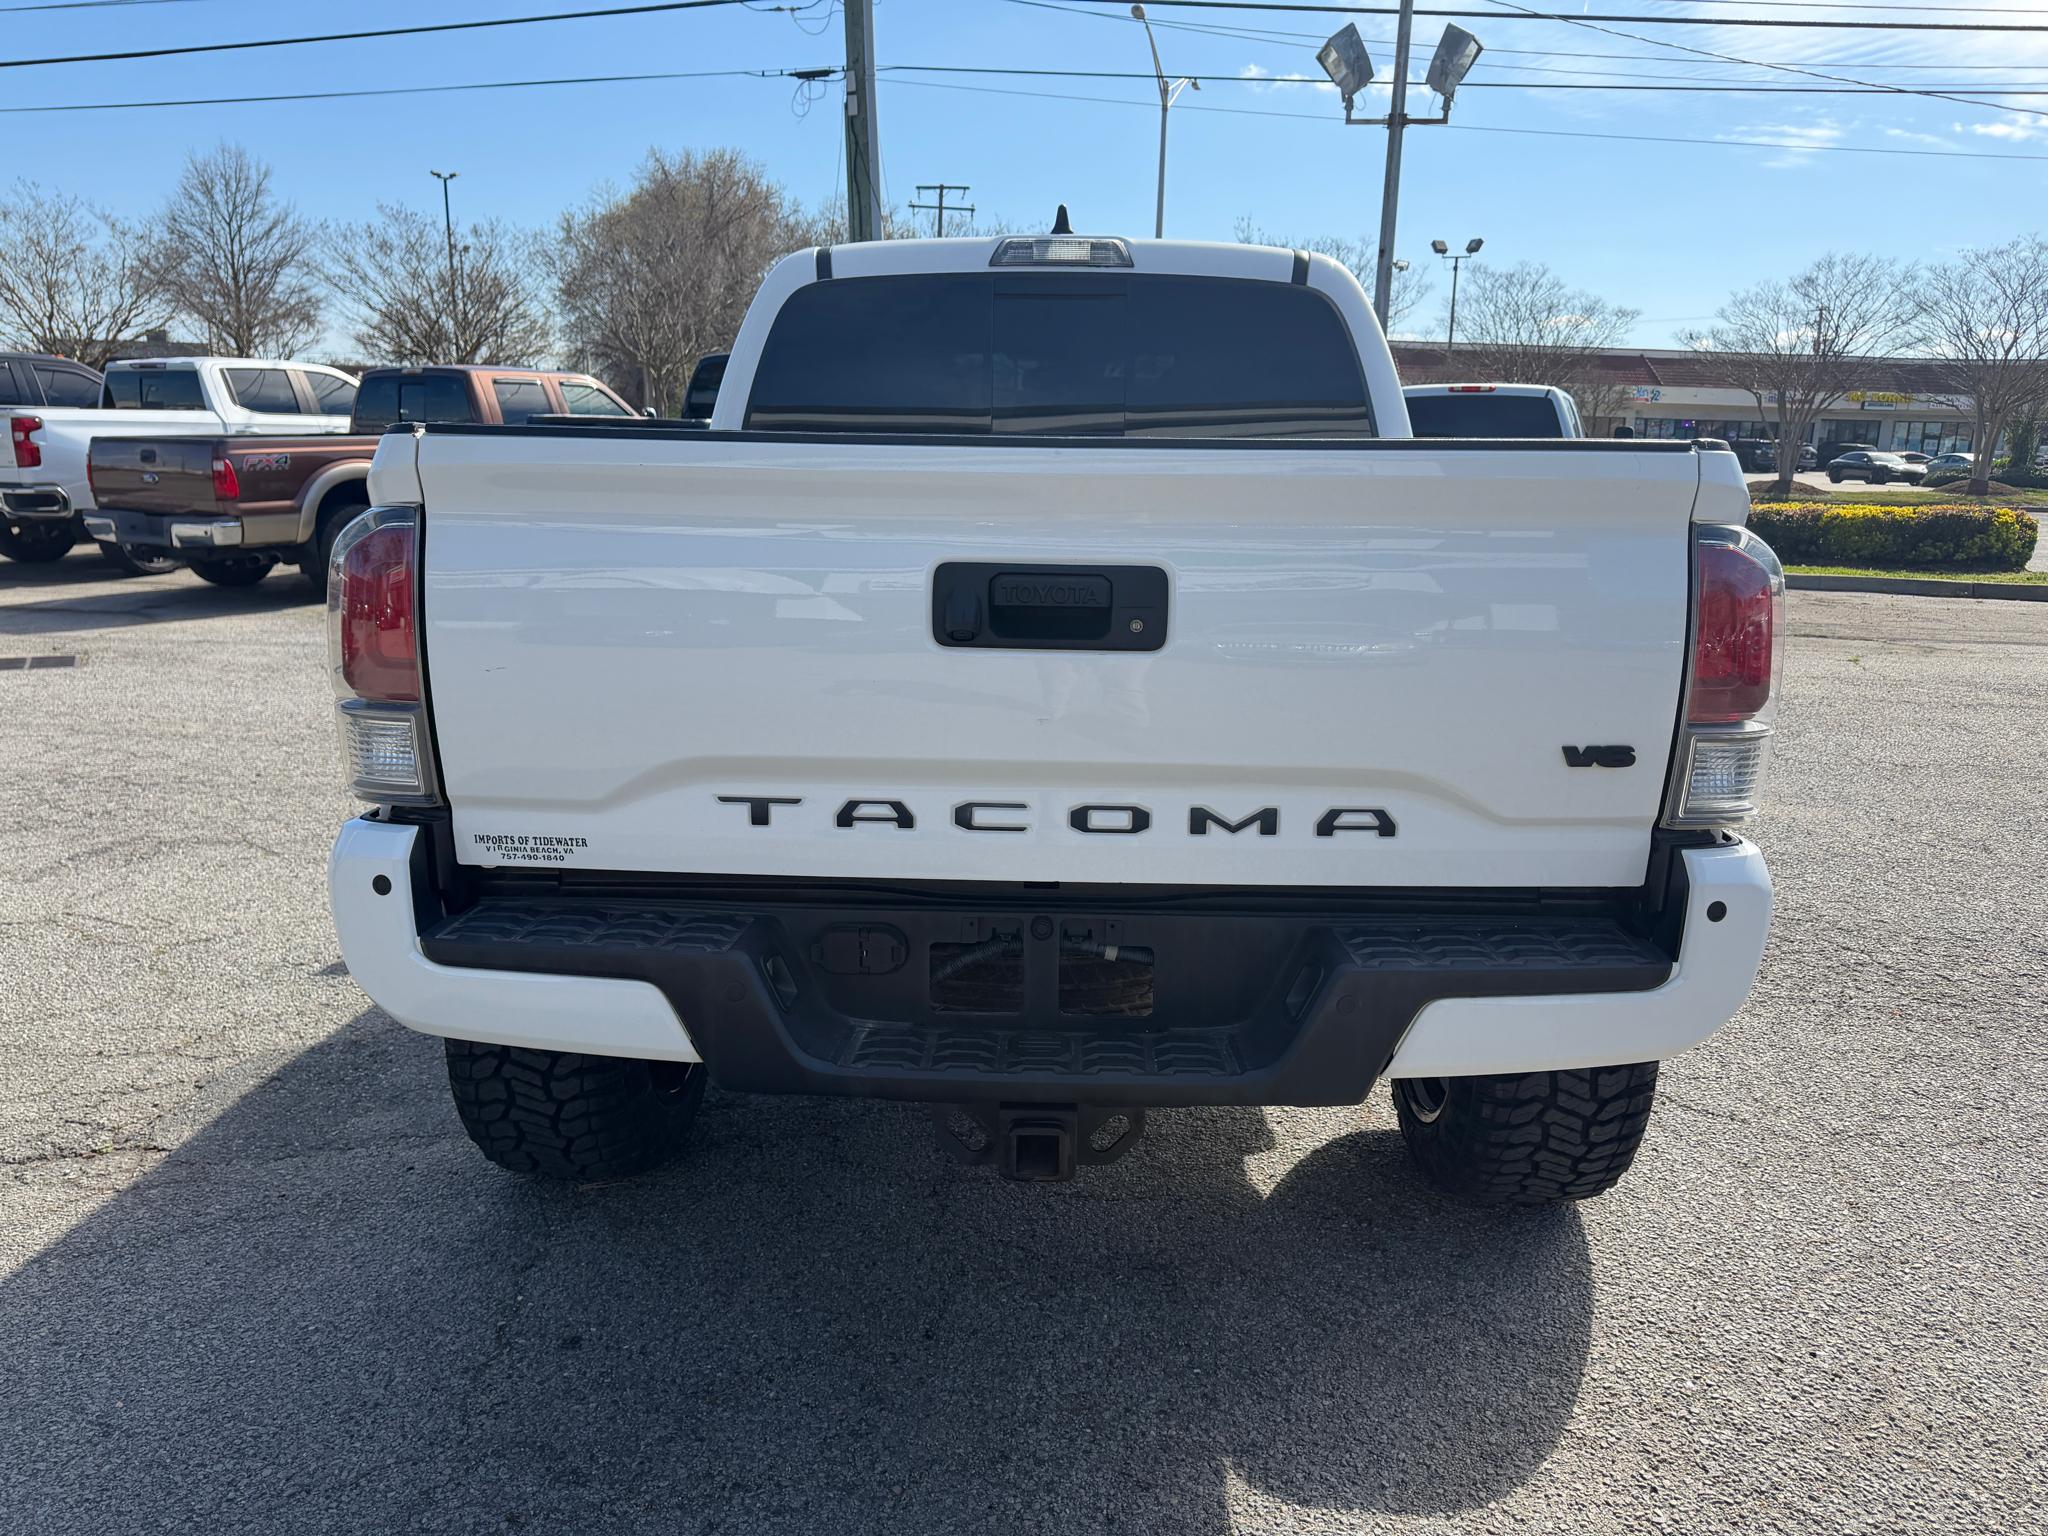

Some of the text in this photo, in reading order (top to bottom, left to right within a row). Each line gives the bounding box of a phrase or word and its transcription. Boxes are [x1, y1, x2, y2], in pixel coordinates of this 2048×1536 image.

[1001, 584, 1101, 605] TOYOTA
[1562, 745, 1637, 768] V6
[717, 795, 1398, 838] TACOMA
[474, 834, 588, 847] IMPORTS OF TIDEWATER
[501, 852, 565, 861] 757-490-1840
